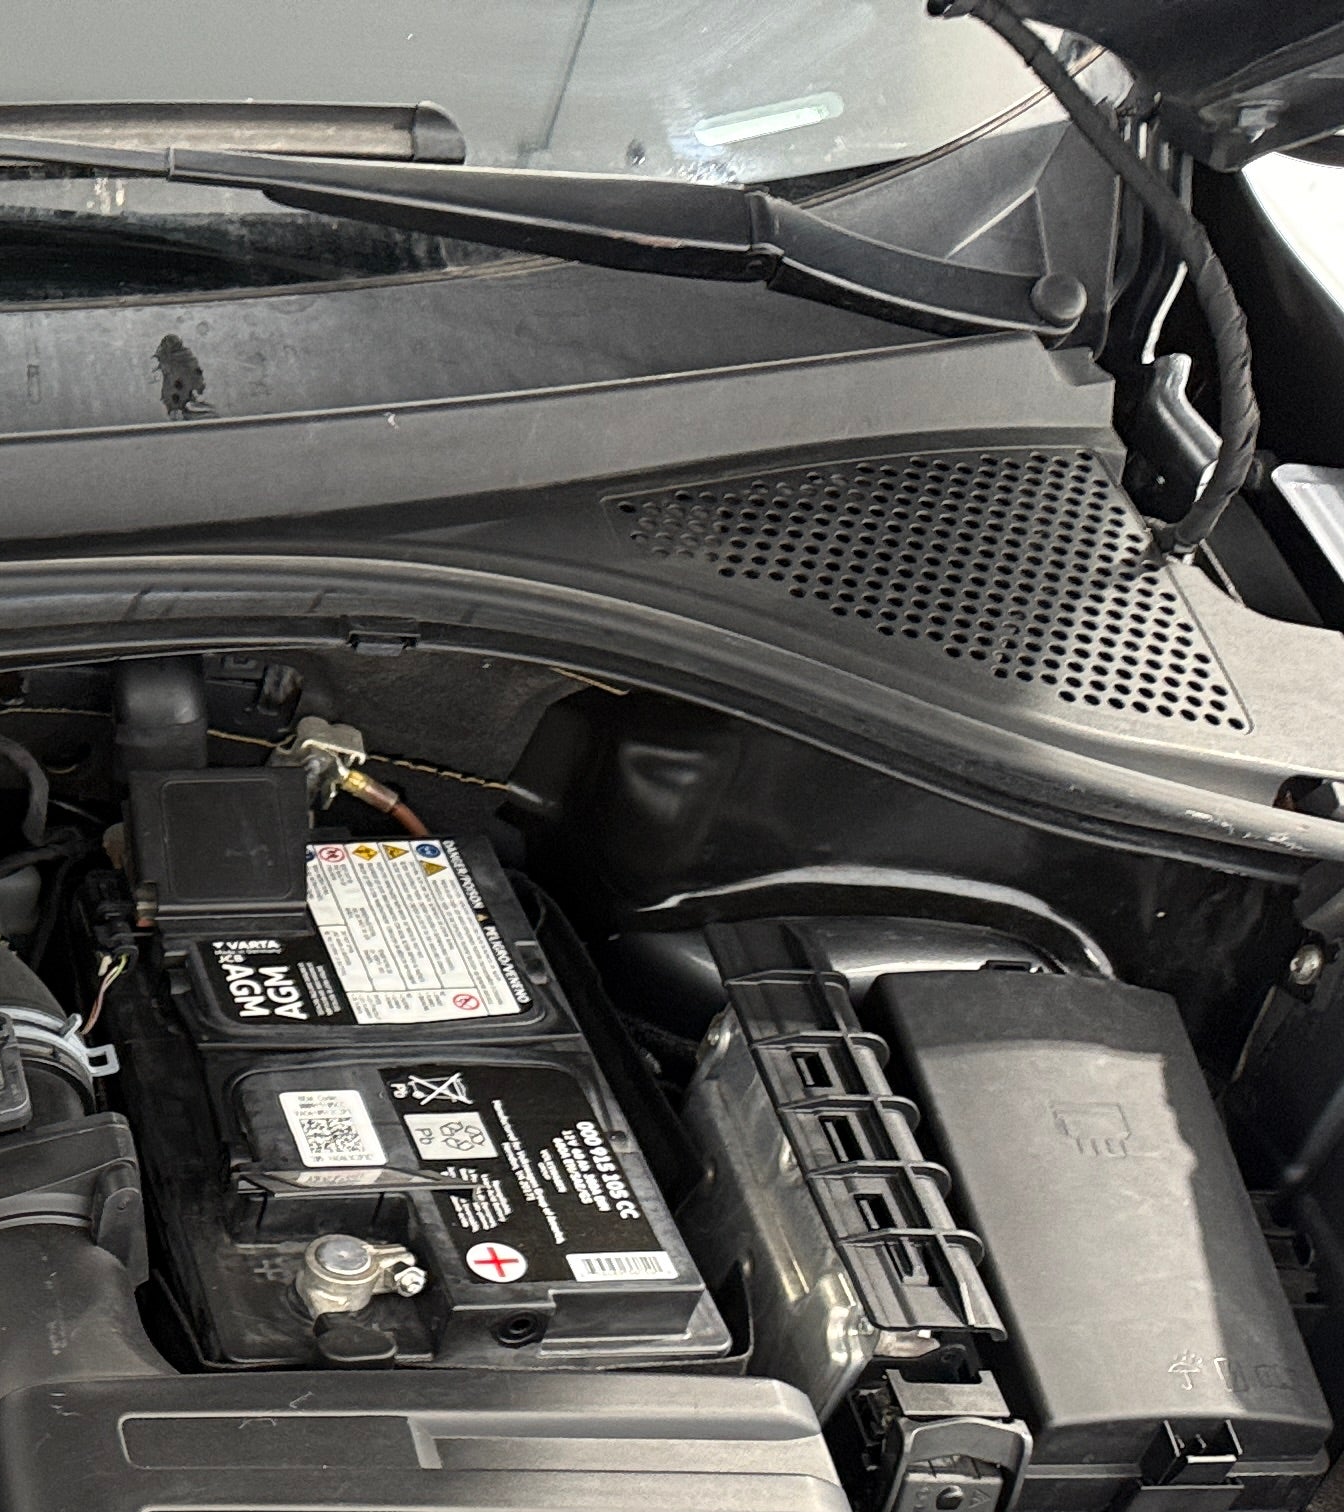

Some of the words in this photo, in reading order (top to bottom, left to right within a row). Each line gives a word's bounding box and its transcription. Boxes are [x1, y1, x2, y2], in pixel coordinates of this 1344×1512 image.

[227, 940, 281, 950] VARTA
[221, 963, 272, 1018] AGM
[258, 965, 310, 1021] AGM
[415, 1128, 436, 1145] Pb
[576, 1121, 603, 1147] 000
[589, 1146, 616, 1173] 915
[602, 1173, 631, 1200] 105
[615, 1200, 641, 1220] CC
